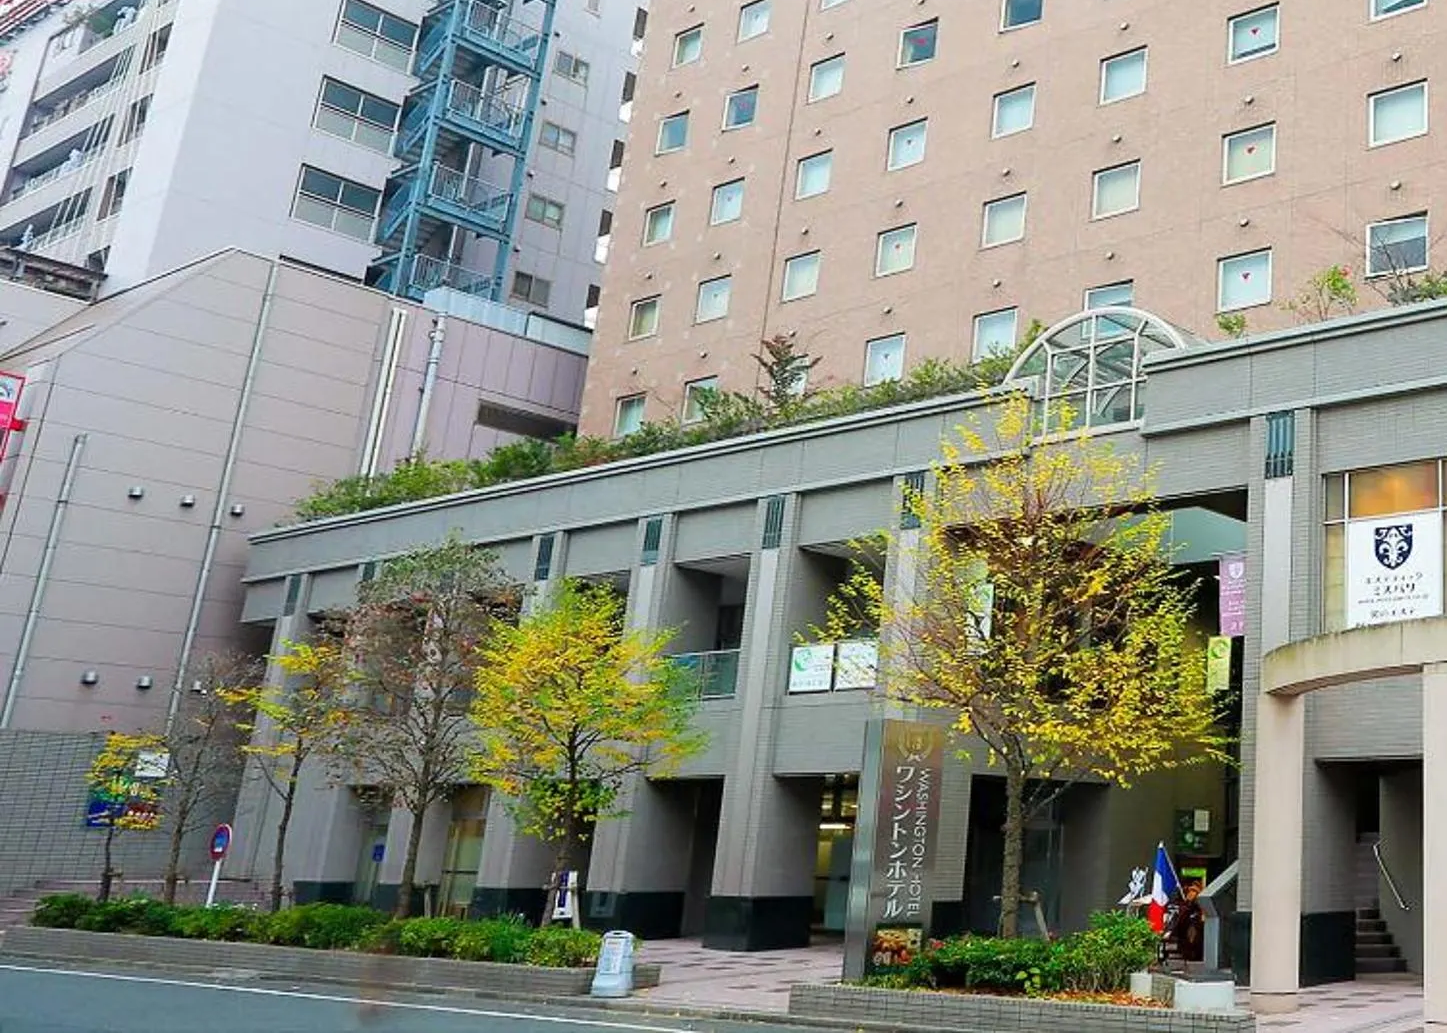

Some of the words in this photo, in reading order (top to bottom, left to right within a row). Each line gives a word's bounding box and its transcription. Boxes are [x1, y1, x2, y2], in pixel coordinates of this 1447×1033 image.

[883, 766, 916, 918] ワシントンホテル
[911, 767, 933, 868] WASHINGTON
